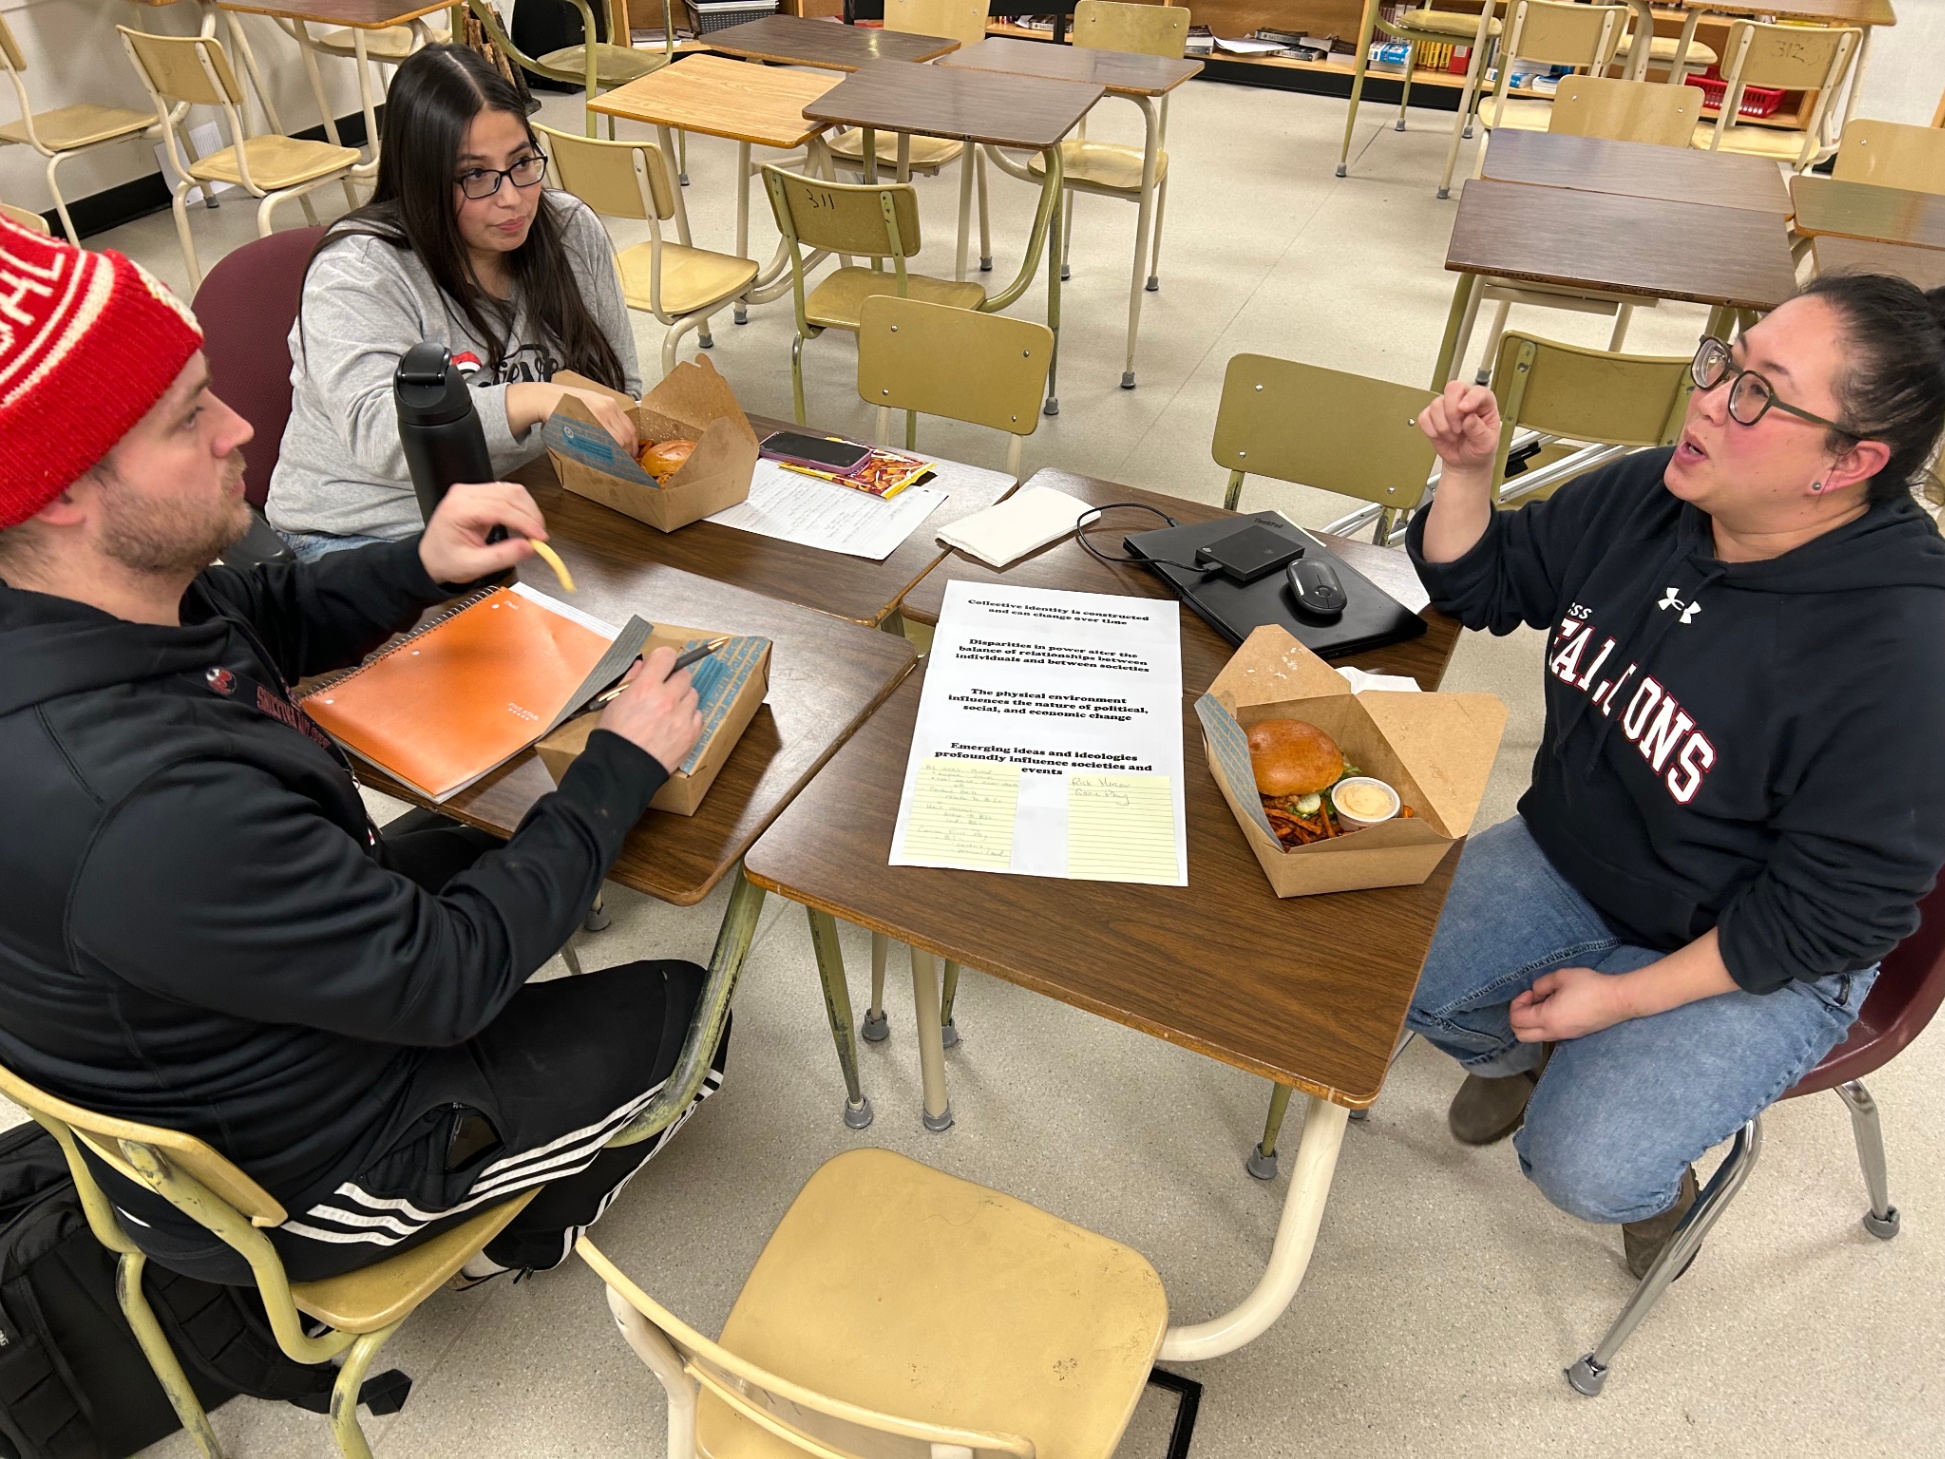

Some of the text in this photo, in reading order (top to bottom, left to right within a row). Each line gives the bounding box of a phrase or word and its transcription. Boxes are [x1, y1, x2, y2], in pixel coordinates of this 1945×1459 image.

[805, 188, 835, 210] 311
[1254, 518, 1283, 528] ThinkPad
[968, 599, 1022, 609] Collective
[1024, 604, 1069, 615] identity
[1082, 611, 1150, 622] constructed
[1033, 612, 1072, 621] change
[959, 645, 1002, 654] balance
[1019, 651, 1096, 661] relationships
[1098, 656, 1148, 666] between
[969, 638, 1032, 649] Disparities
[1048, 646, 1087, 654] power
[955, 653, 1021, 662] individuals
[1047, 659, 1098, 668] between
[1099, 664, 1150, 673] societies
[948, 694, 1010, 705] influences
[1035, 702, 1076, 710] nature
[1093, 705, 1149, 715] political,
[995, 690, 1046, 699] physical
[1048, 694, 1127, 704] environment
[963, 704, 1132, 722] social, and economic change
[934, 751, 1007, 763] profoundly
[1009, 755, 1069, 767] influence
[1071, 761, 1126, 770] societies
[950, 742, 1138, 762] Emerging ideas and ideologies
[1021, 767, 1063, 776] events
